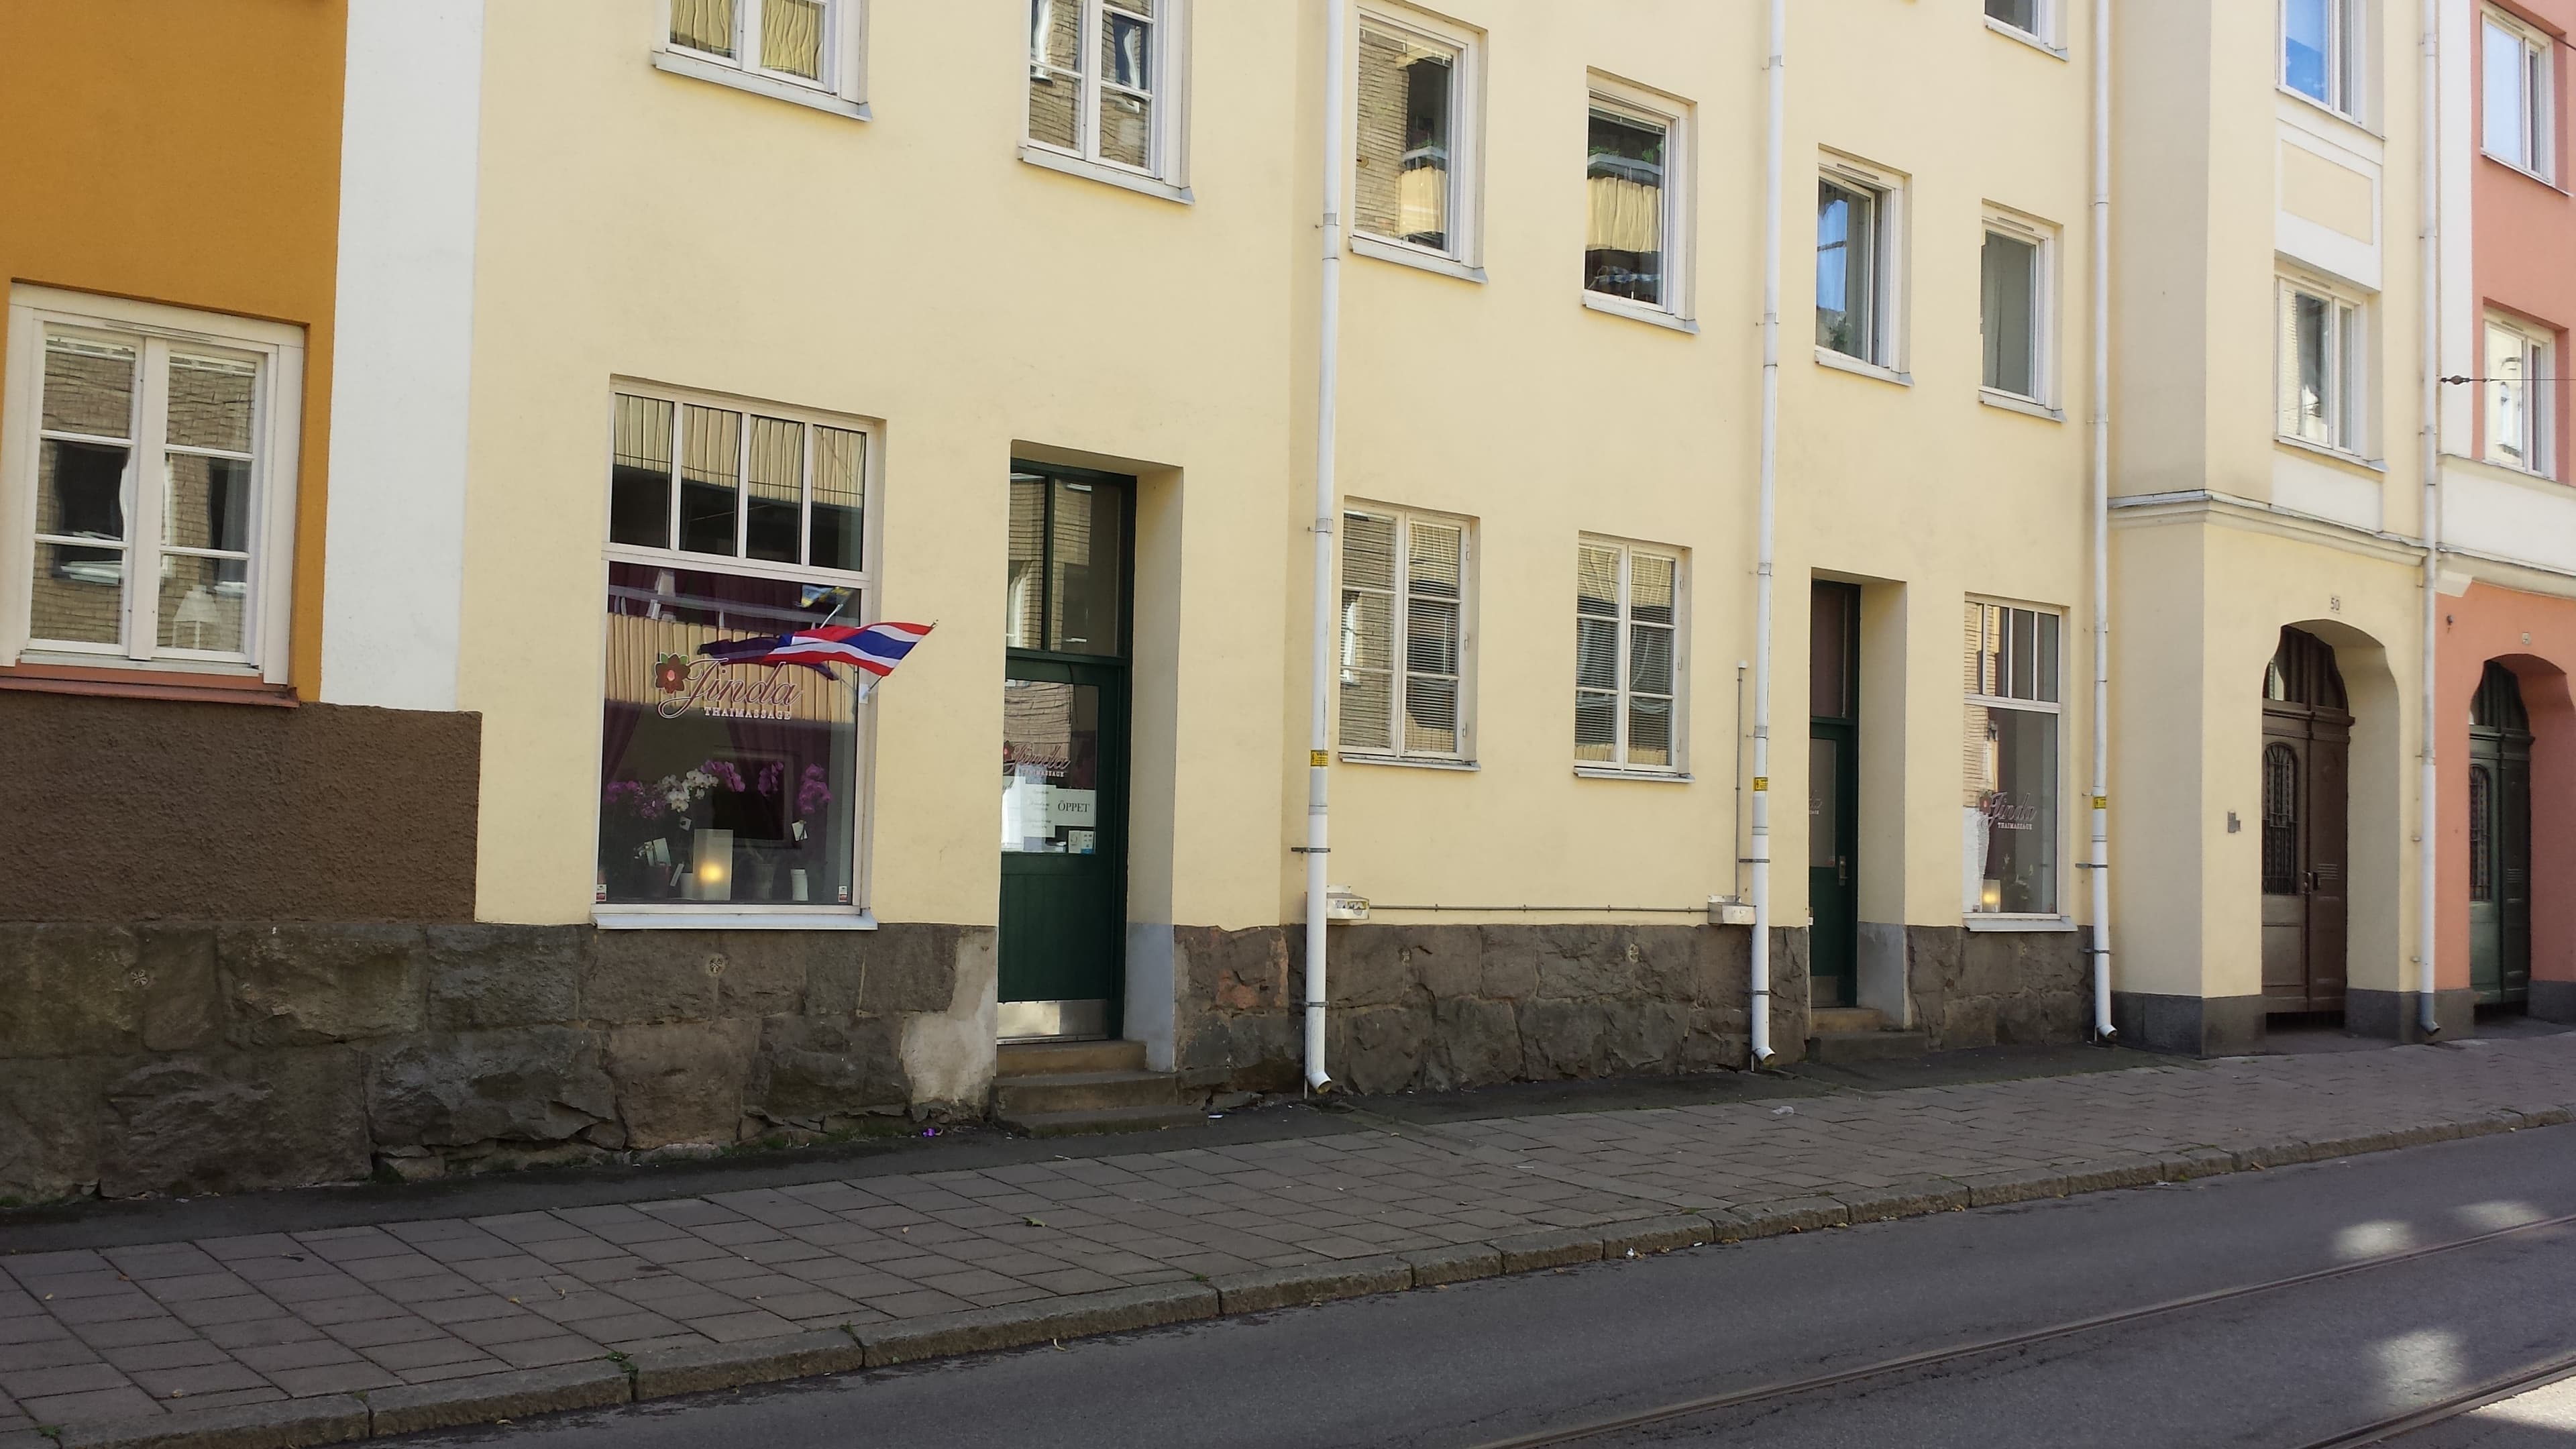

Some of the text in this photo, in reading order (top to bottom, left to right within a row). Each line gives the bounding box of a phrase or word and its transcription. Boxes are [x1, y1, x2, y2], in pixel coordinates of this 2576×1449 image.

[2330, 597, 2340, 610] 50
[657, 657, 803, 718] Jinda
[704, 707, 792, 720] THAIMASSAGE
[1058, 800, 1089, 812] ÖPPET
